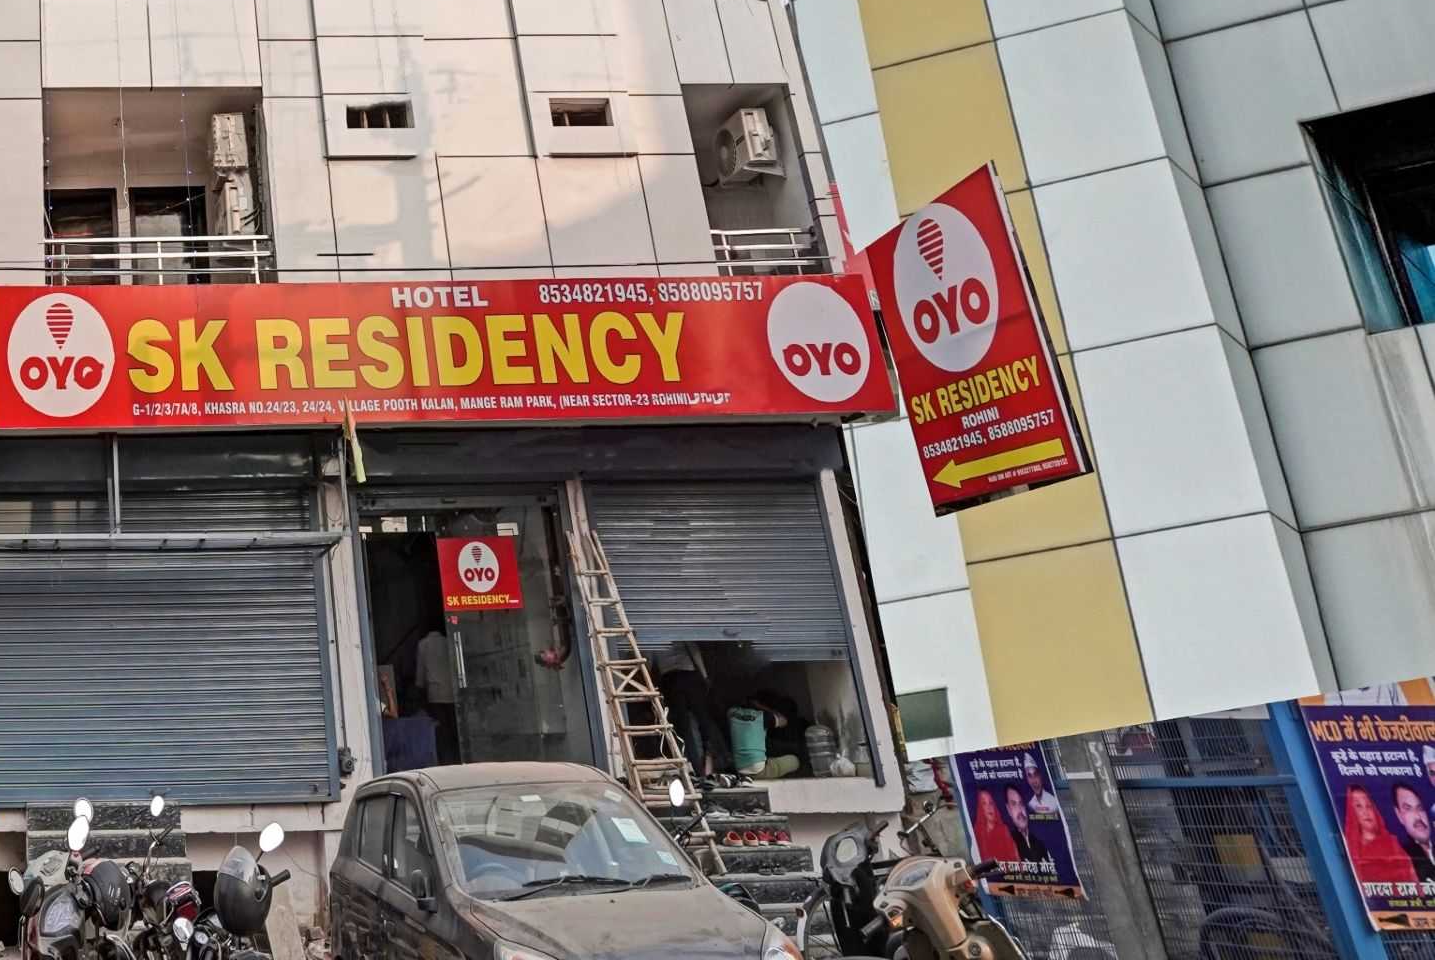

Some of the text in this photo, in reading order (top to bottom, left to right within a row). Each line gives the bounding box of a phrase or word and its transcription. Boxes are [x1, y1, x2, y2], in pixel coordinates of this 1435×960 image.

[391, 286, 489, 308] HOTEL
[538, 281, 764, 305] 8534821945, 8588095757
[914, 277, 990, 344] OYO
[127, 311, 686, 394] SK RESIDENCY
[781, 342, 862, 378] OYO
[19, 355, 104, 391] OYO
[205, 401, 246, 414] KHASRA
[384, 398, 418, 411] POOTH
[421, 397, 458, 412] KALAN,
[460, 397, 498, 409] MANGE
[500, 396, 524, 408] RAM
[526, 395, 557, 409] PARK,
[560, 394, 590, 409] (NEAR
[592, 394, 650, 407] SECTOR-23
[911, 356, 1041, 425] SK RESIDENCY
[961, 406, 1001, 430] ROHINI
[923, 408, 1055, 460] 8534821945, 8588095757
[464, 567, 496, 582] OYO
[446, 594, 510, 607] SK RESIDENCY
[1309, 720, 1343, 742] MCD
[1340, 715, 1359, 742] में
[1356, 714, 1378, 742] भी
